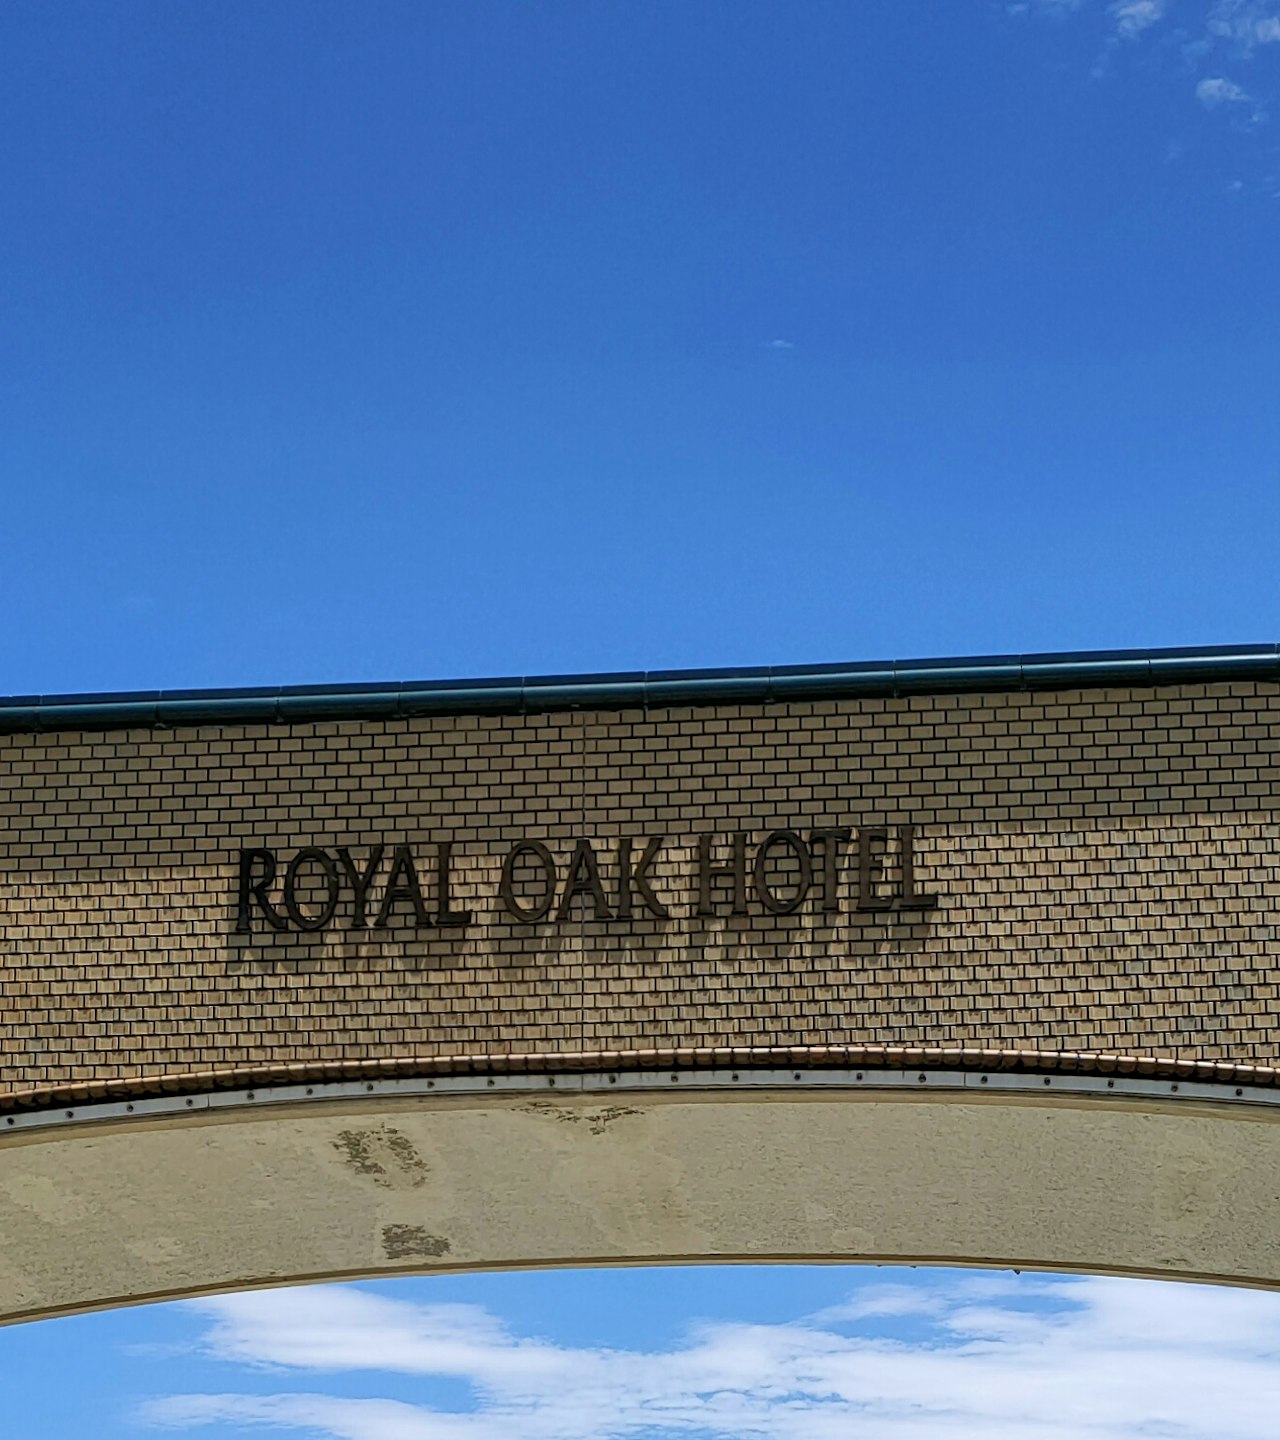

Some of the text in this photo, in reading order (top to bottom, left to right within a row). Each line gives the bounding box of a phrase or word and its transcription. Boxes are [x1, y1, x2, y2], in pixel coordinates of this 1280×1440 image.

[235, 826, 938, 931] ROYAL OAK HOTEL
